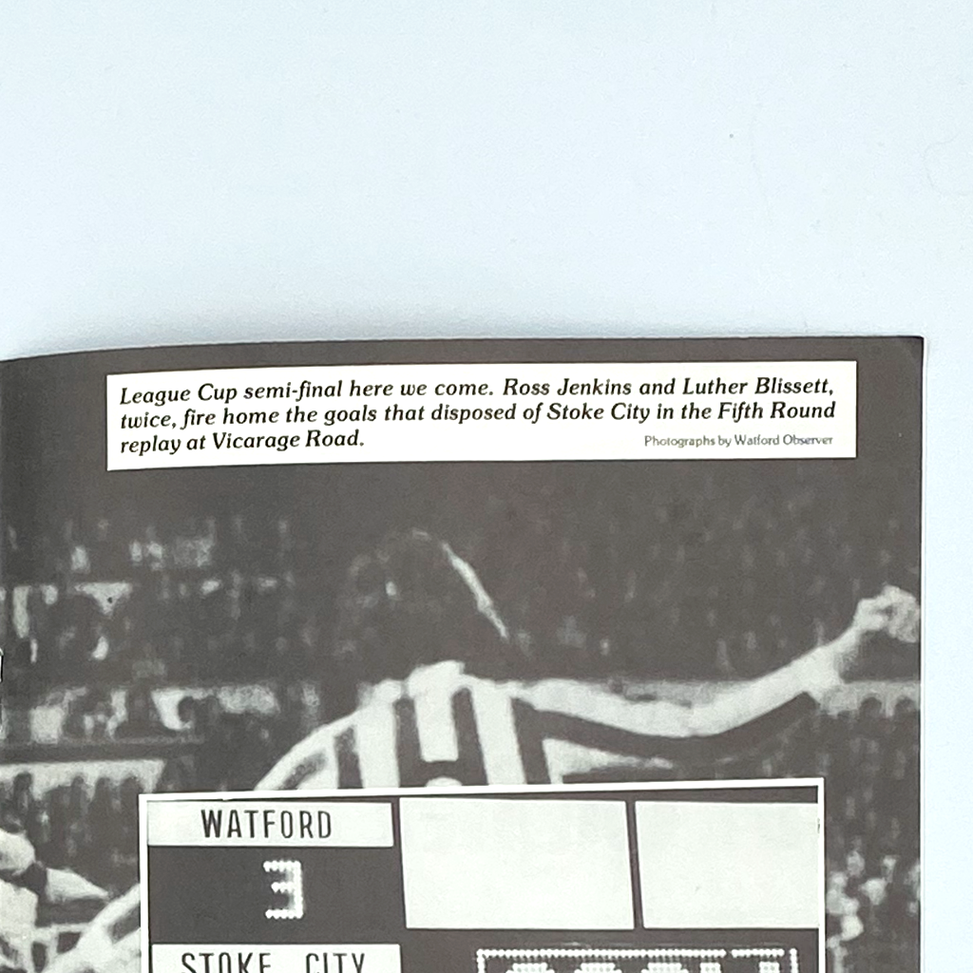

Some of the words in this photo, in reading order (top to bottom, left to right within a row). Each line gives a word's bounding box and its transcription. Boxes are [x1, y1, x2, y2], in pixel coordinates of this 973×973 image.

[119, 387, 191, 407] League
[197, 382, 238, 404] Cup
[243, 379, 343, 403] semi-final
[349, 379, 394, 397] here
[400, 384, 428, 396] we
[434, 383, 494, 396] come.
[502, 378, 550, 396] Ross
[556, 377, 632, 396] Jenkins
[639, 377, 676, 396] and
[682, 377, 749, 395] Luther
[754, 376, 834, 396] Blissett,
[120, 411, 177, 429] twice,
[179, 408, 216, 431] fire
[222, 407, 280, 425] home
[285, 405, 318, 423] the
[323, 404, 377, 427] goals
[384, 403, 425, 421] that
[431, 402, 517, 425] disposed
[522, 401, 544, 425] of
[546, 402, 605, 420] Stoke
[610, 402, 651, 424] City
[656, 403, 674, 420] in
[681, 401, 712, 420] the
[717, 401, 764, 424] Fifth
[769, 400, 836, 419] Round
[120, 434, 182, 457] replay
[186, 435, 206, 451] at
[212, 431, 301, 452] Vicarage
[305, 428, 364, 448] Road.
[644, 435, 716, 449] Photographs
[717, 434, 732, 448] by
[734, 433, 780, 446] Watford
[782, 433, 834, 446] Observer
[200, 809, 332, 839] WATFORD
[262, 859, 305, 920] 3
